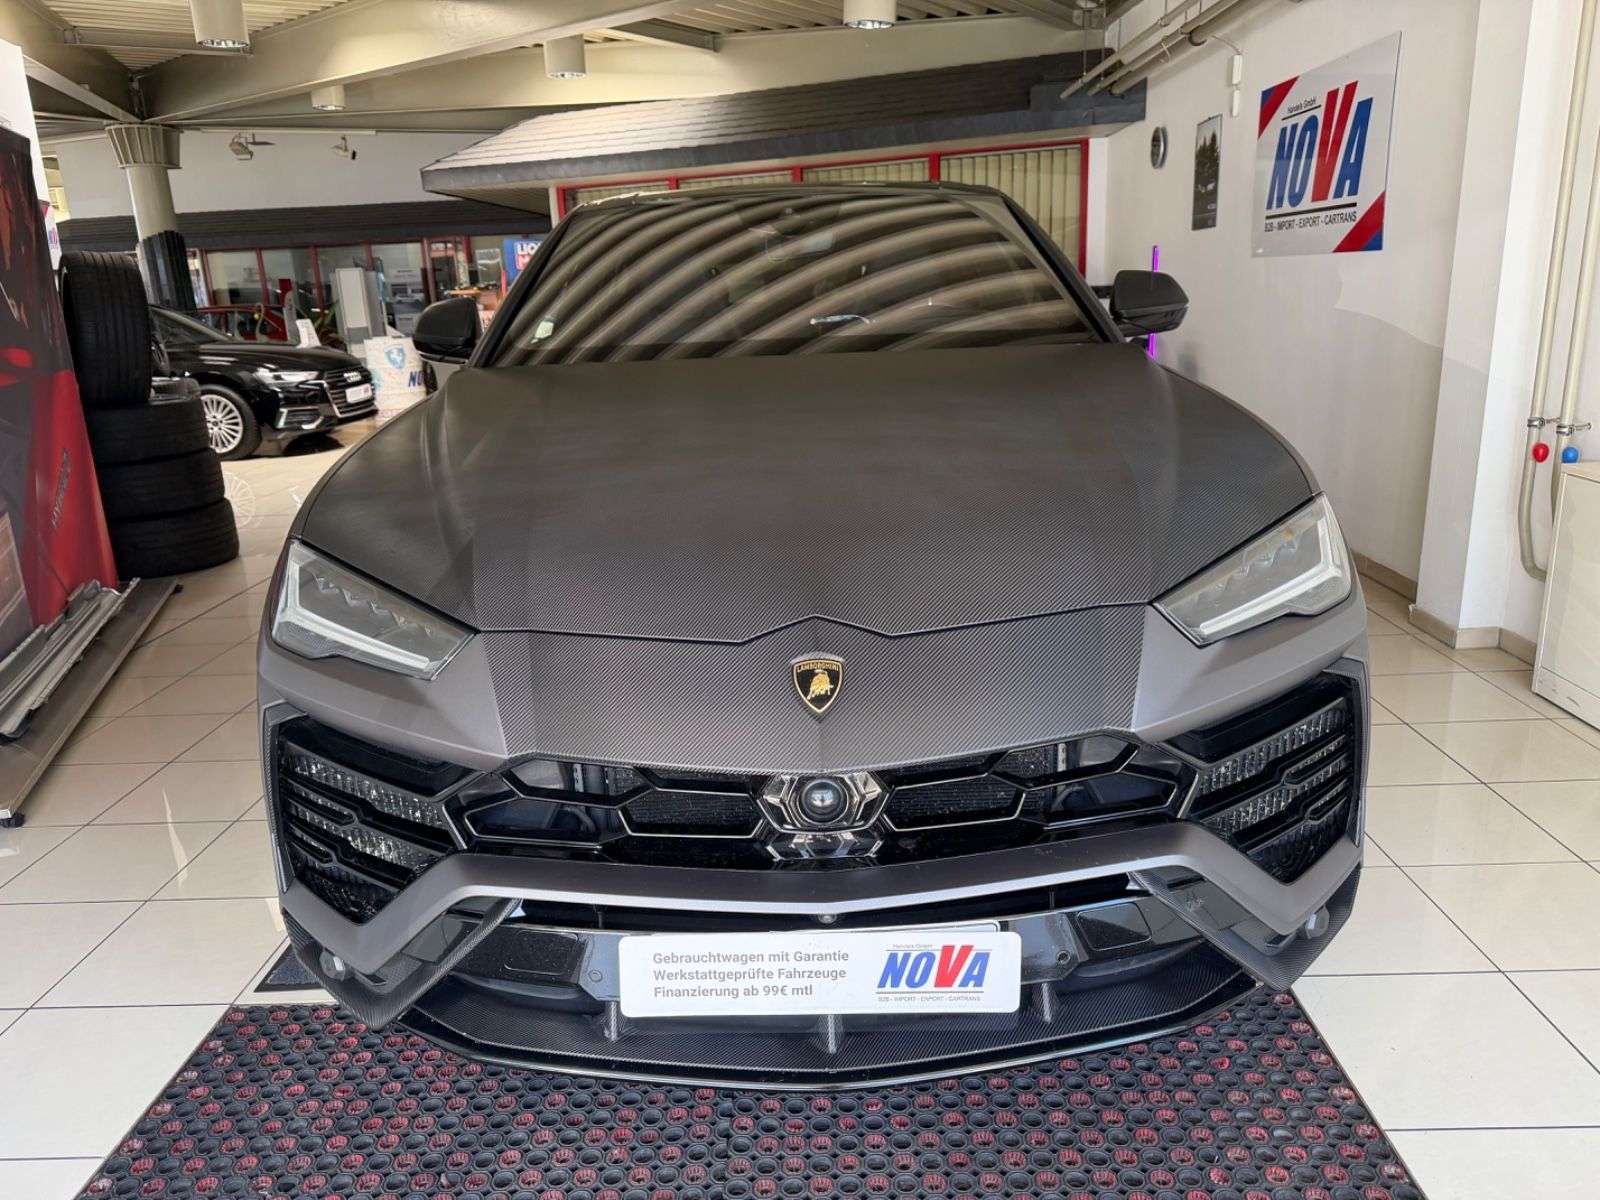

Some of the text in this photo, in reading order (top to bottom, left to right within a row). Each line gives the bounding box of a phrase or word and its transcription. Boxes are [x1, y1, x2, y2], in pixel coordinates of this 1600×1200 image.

[1266, 80, 1373, 210] NOVA
[1300, 215, 1320, 228] EXPORT
[1325, 211, 1357, 225] CARTRANS
[653, 950, 849, 966] Gebrauchtwagen mit Garantie
[653, 967, 847, 982] Werkstattgeprüfte Fahrzeuge
[877, 945, 991, 988] NOVA
[654, 984, 813, 999] Finanzierung ab 99€ mtl
